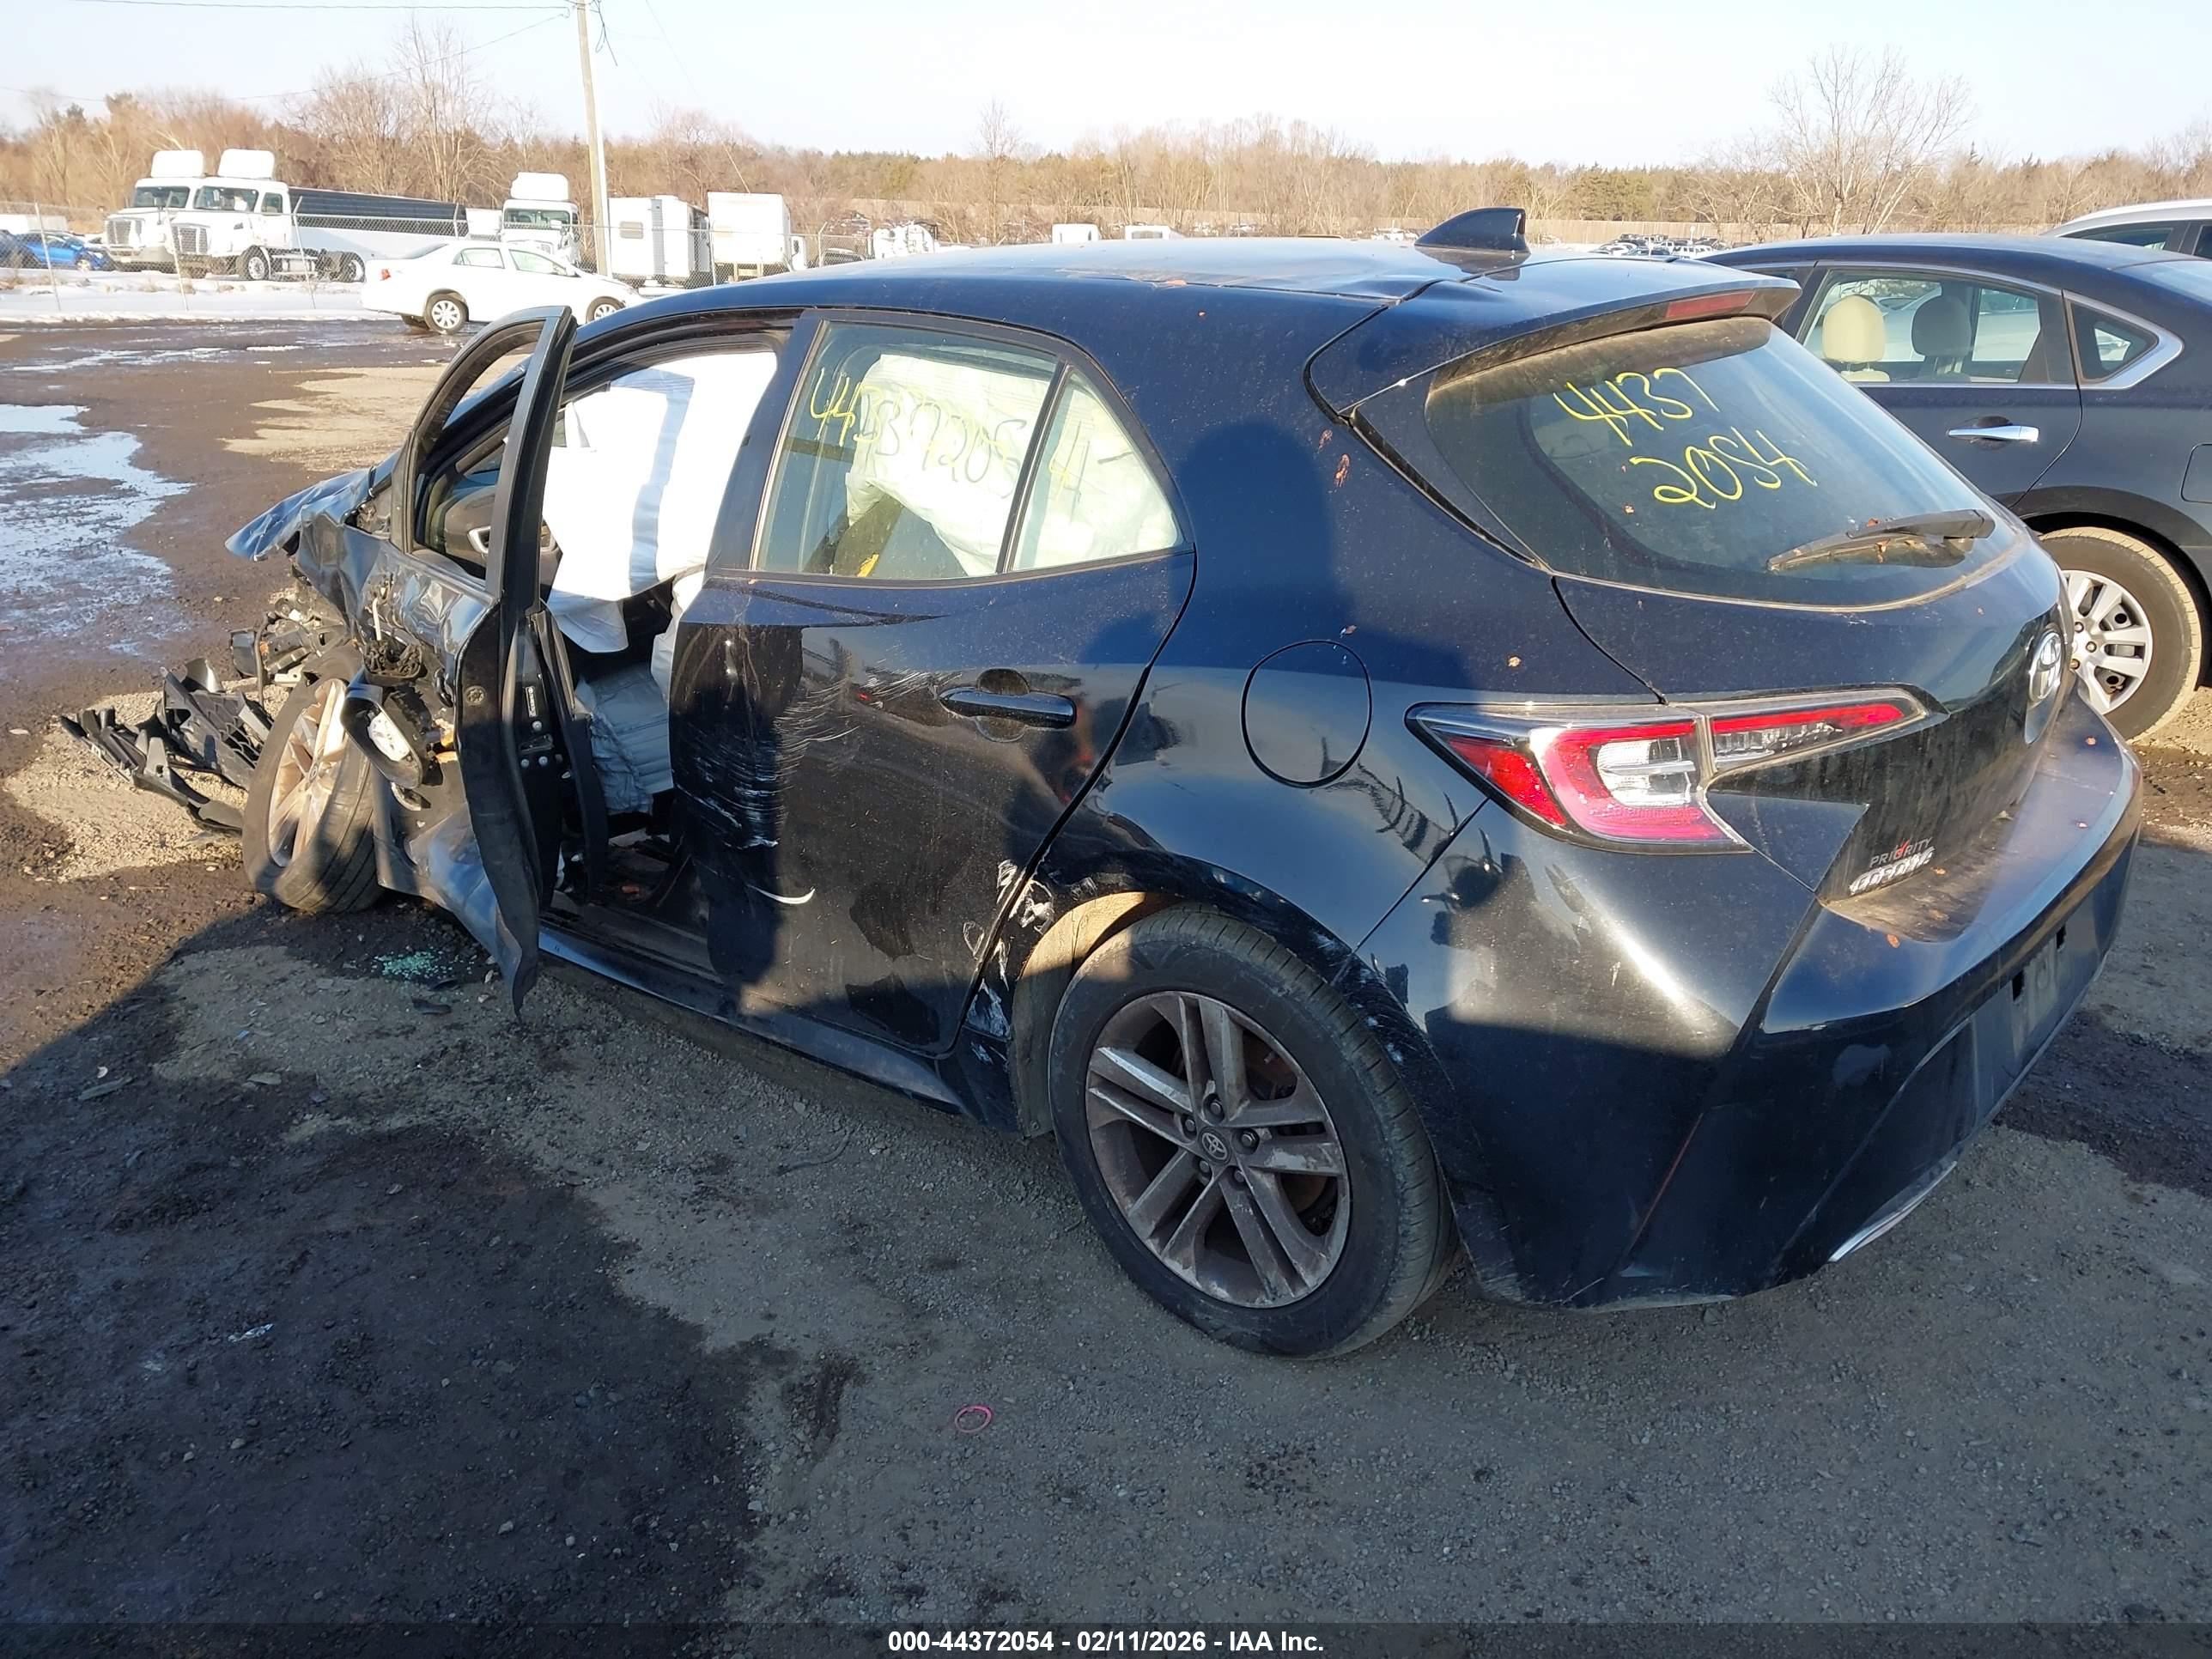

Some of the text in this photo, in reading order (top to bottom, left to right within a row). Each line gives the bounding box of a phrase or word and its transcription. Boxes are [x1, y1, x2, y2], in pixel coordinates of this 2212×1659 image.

[1553, 368, 1720, 447] 4437
[1629, 426, 1818, 508] 2054
[1869, 836, 1934, 868] PRIORITY
